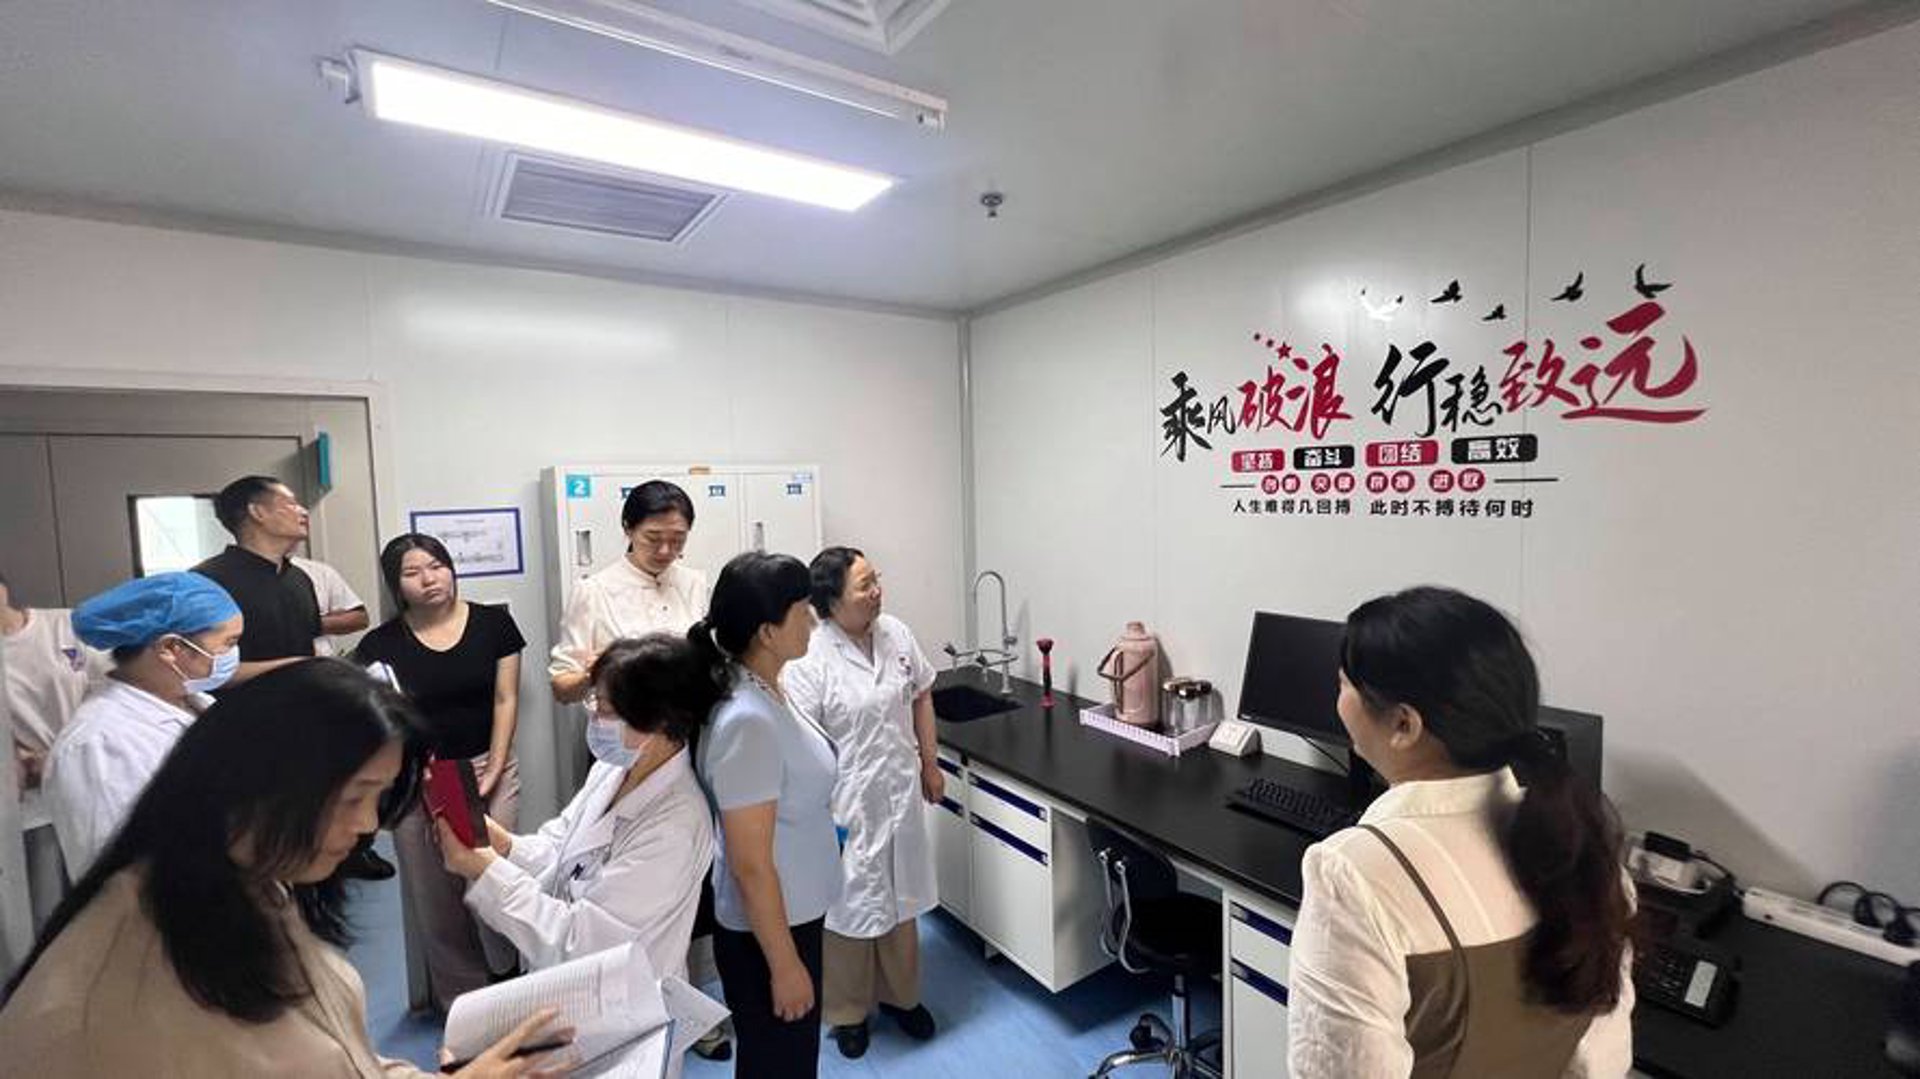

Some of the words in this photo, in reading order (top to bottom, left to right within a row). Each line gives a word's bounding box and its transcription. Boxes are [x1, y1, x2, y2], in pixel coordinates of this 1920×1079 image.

[1160, 343, 1353, 462] 乘风破浪
[1371, 302, 1706, 437] 行稳致远
[1304, 448, 1342, 467] 奋斗
[1379, 443, 1422, 464] 团结
[1468, 438, 1520, 460] 高效
[1233, 499, 1351, 515] 人生难得几回搏
[1370, 499, 1534, 517] 此时不搏待何时
